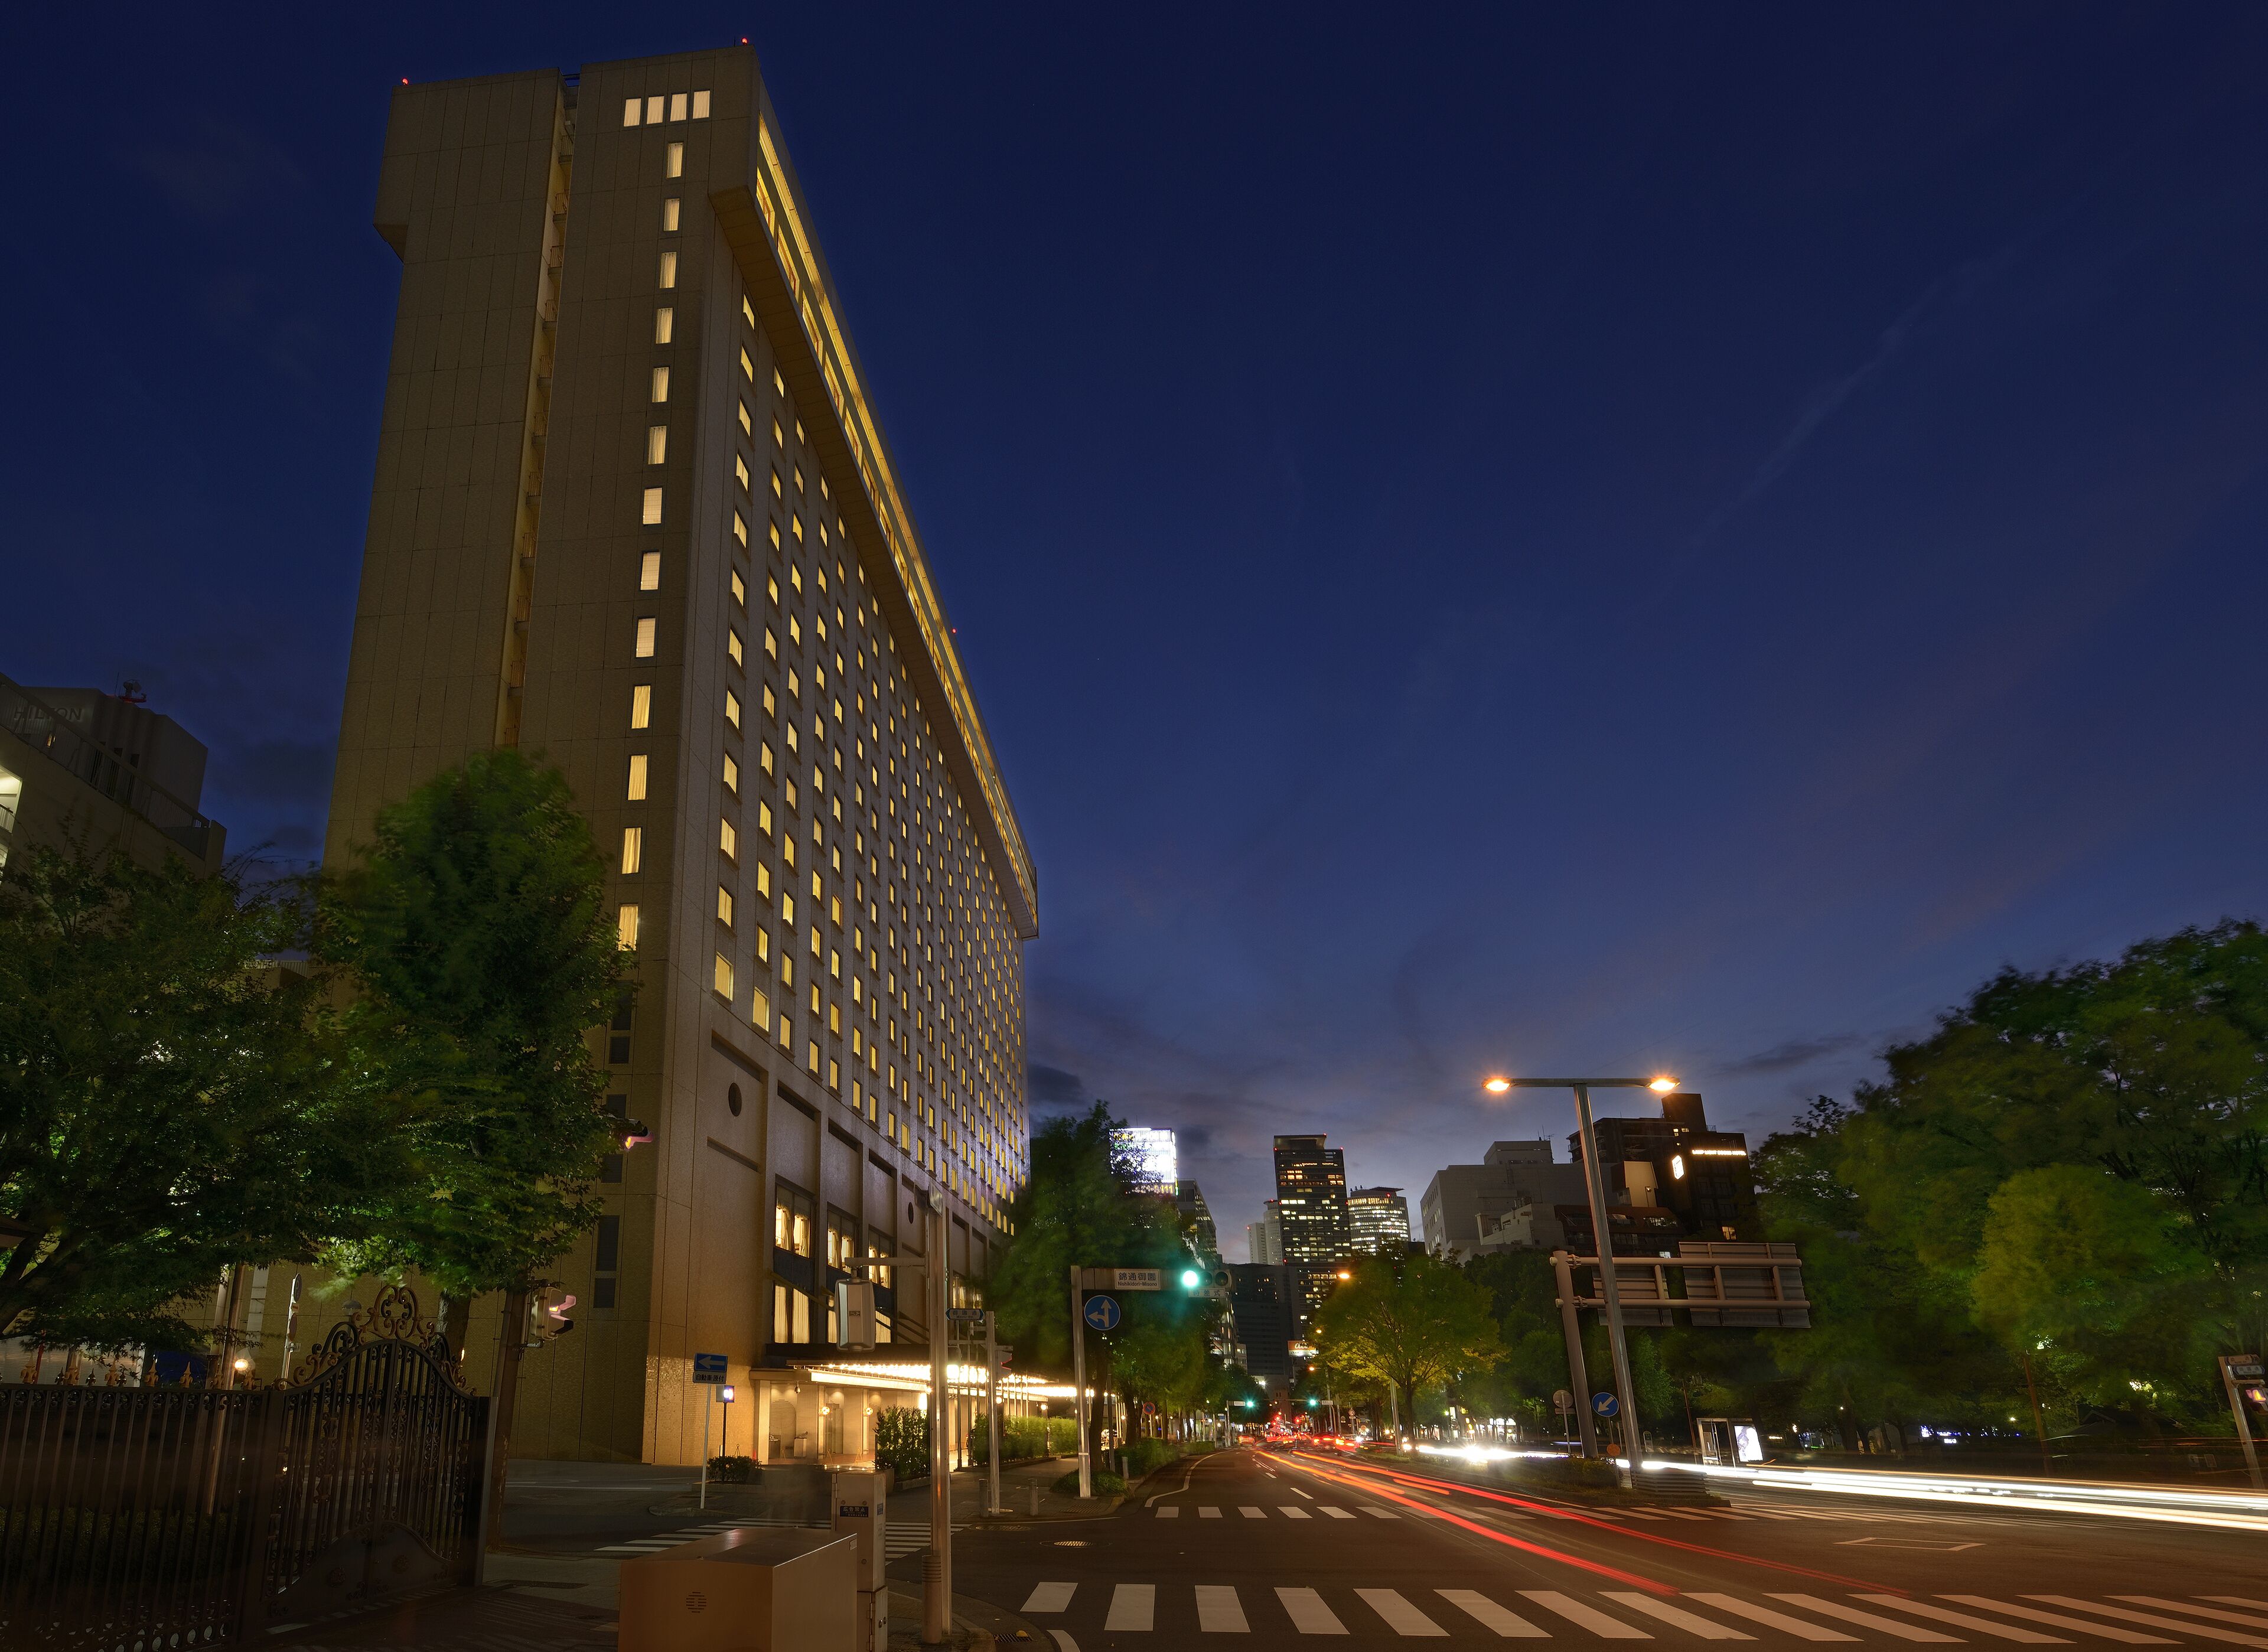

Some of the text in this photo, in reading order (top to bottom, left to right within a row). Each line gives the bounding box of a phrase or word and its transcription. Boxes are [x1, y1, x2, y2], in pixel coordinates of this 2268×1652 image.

[13, 706, 82, 721] HILON
[1118, 1272, 1156, 1280] 錦通御園
